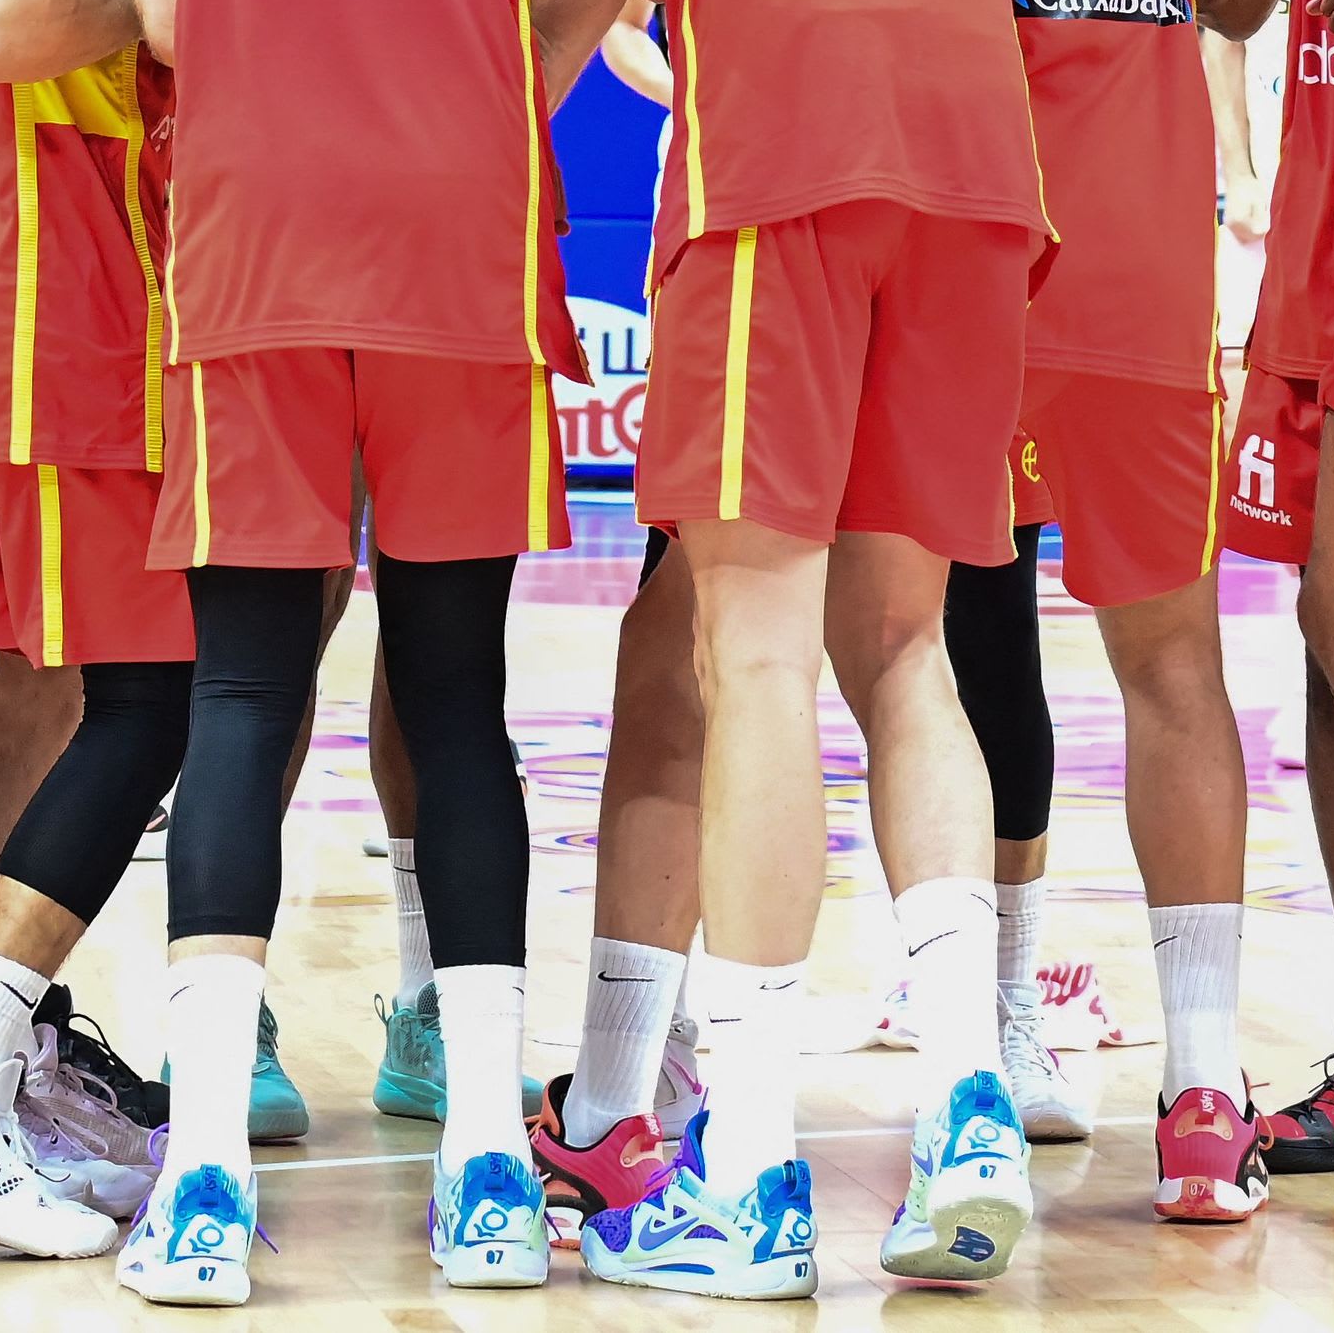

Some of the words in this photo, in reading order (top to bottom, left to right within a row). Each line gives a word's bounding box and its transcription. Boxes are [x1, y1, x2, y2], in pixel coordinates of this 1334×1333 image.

[1238, 433, 1276, 508] fi
[1229, 493, 1293, 527] network
[1189, 1183, 1207, 1197] 07
[486, 1249, 504, 1265] 07
[198, 1266, 216, 1282] 07
